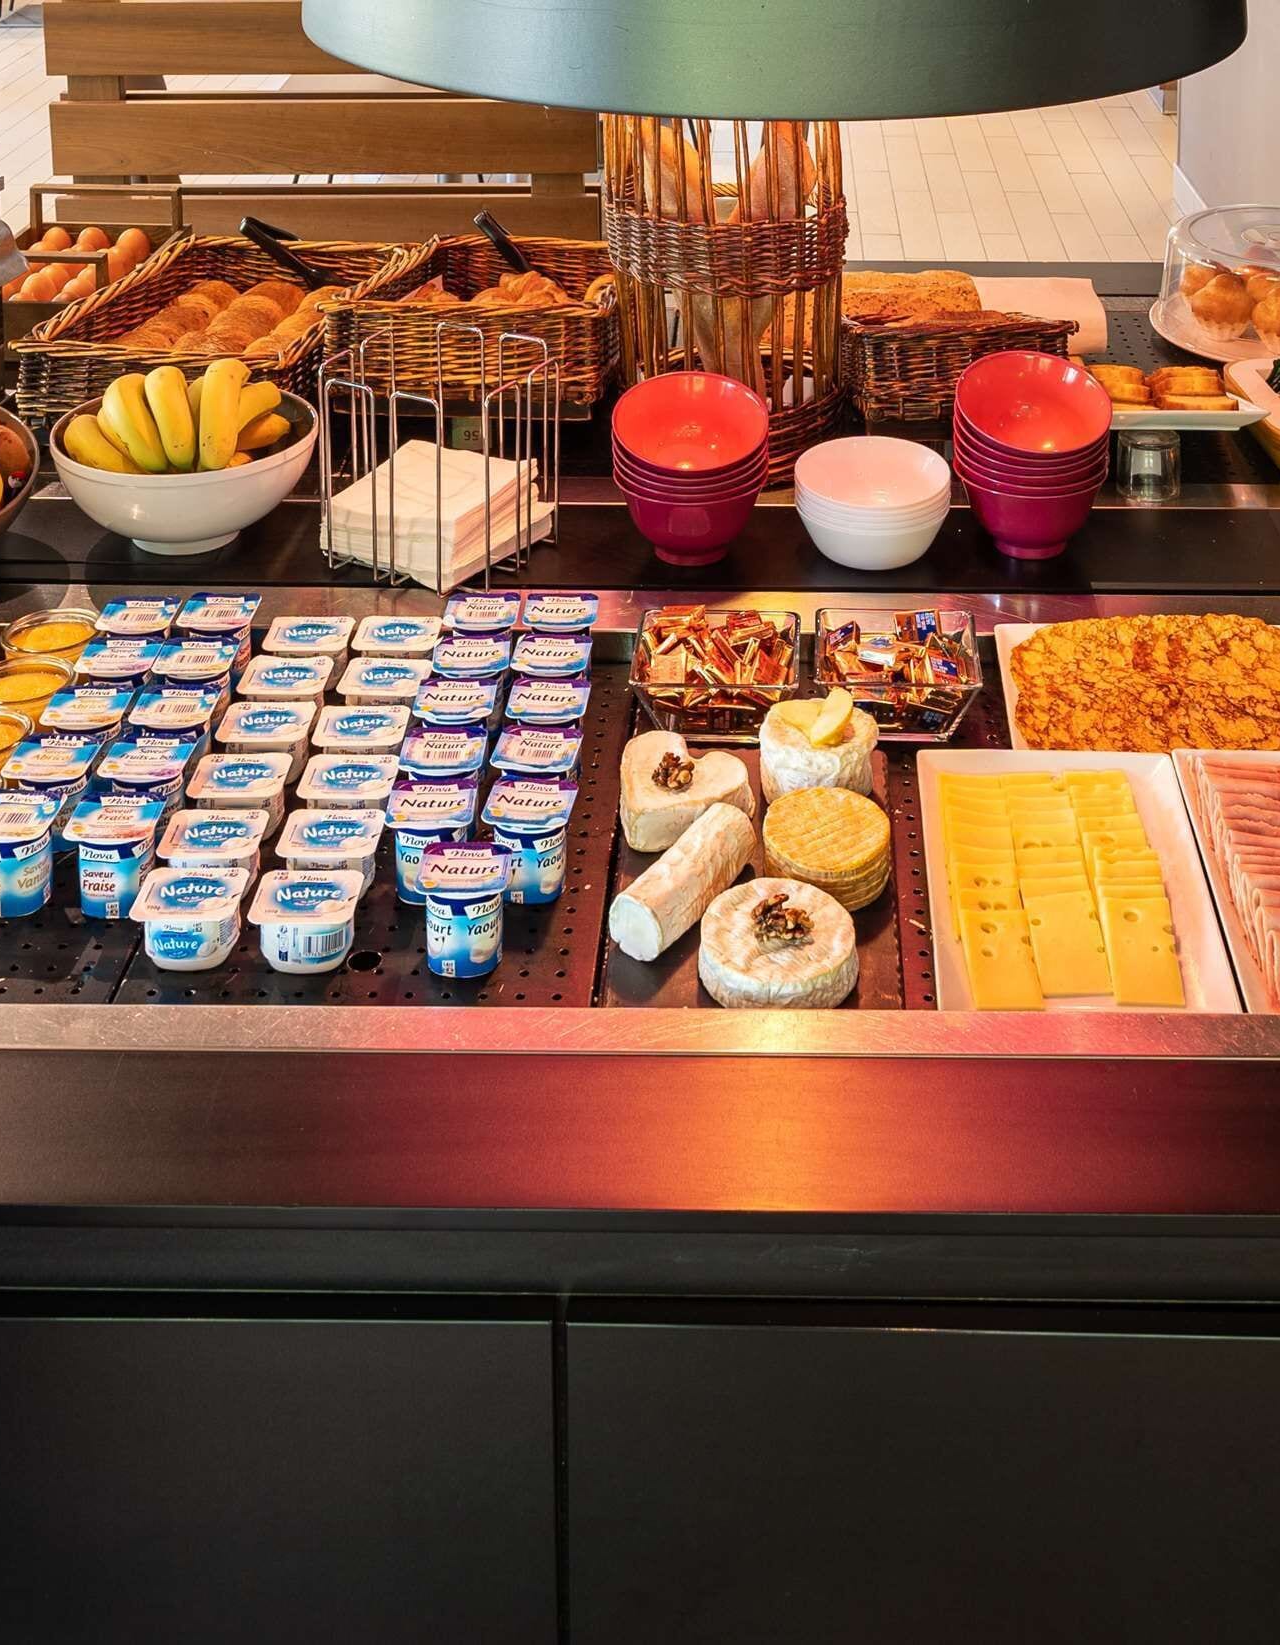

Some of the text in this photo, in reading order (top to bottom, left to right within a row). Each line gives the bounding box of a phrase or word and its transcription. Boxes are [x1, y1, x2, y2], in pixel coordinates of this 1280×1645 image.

[531, 606, 586, 614] Nature
[285, 624, 338, 637] Nature
[373, 624, 425, 637] Nature
[442, 649, 500, 658] Nature
[521, 648, 579, 658] Nature
[261, 669, 315, 681] Nature
[361, 669, 415, 681] Nature
[425, 692, 485, 701] Nature
[517, 693, 577, 702] Nature
[240, 714, 297, 727] Nature
[335, 716, 392, 730] Nature
[424, 741, 467, 750] Nature
[521, 740, 562, 749] Nature
[213, 766, 273, 780] Nature
[321, 768, 381, 781] Nature
[521, 784, 553, 792] Nova
[400, 798, 465, 808] Nature
[497, 794, 562, 807] Nature
[185, 824, 247, 840] Nature
[303, 824, 365, 839] Nature
[82, 848, 114, 860] Nova
[400, 850, 419, 865] Yao
[451, 850, 485, 858] Nova
[82, 869, 115, 879] Saveur
[431, 864, 500, 876] Nature
[82, 880, 116, 893] Fraise
[160, 883, 226, 898] Nature
[276, 887, 342, 902] Nature
[153, 938, 198, 951] Nature
